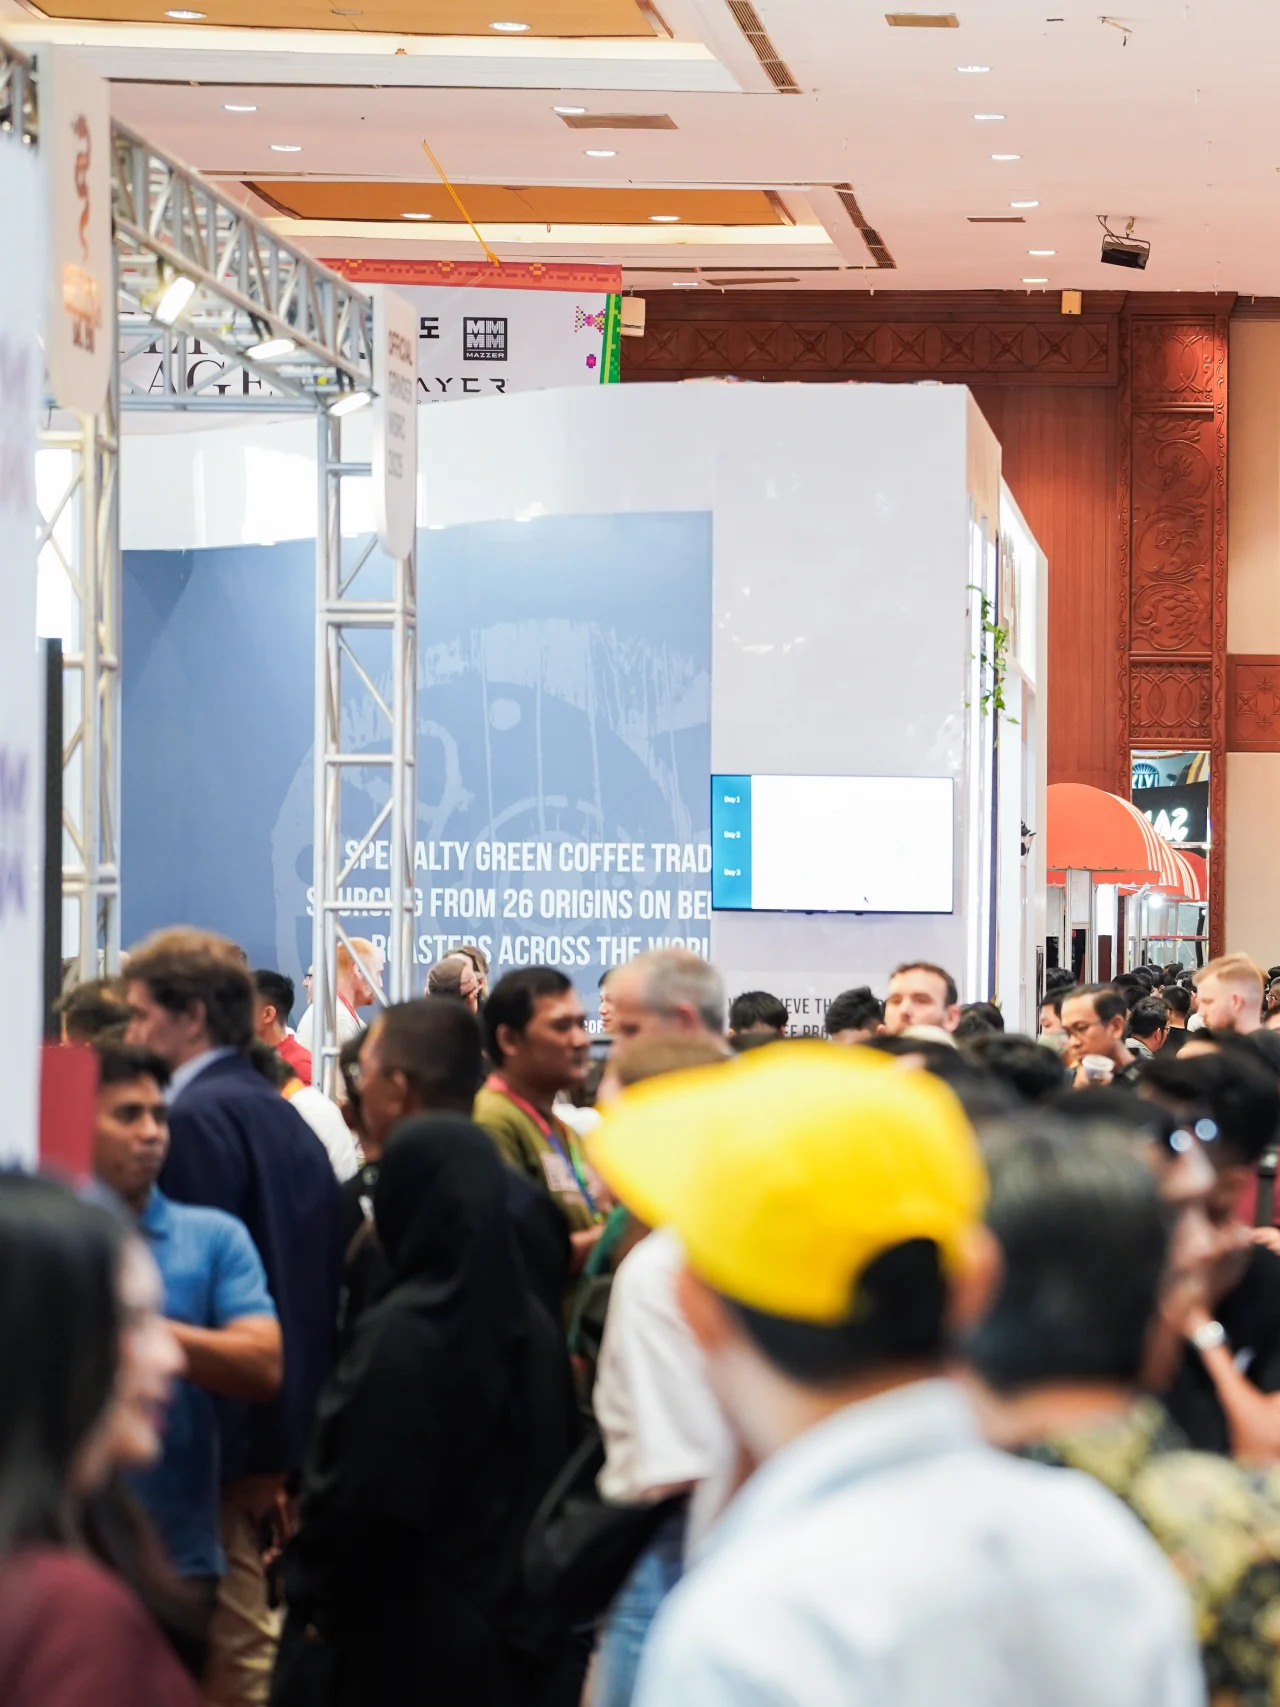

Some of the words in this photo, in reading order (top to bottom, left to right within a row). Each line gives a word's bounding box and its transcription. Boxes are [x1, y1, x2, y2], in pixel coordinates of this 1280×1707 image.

[345, 840, 469, 871] SPEALTY
[476, 841, 552, 872] GREEN
[559, 842, 645, 873] COFFEE
[651, 843, 711, 873] TRAD
[430, 888, 496, 918] FROM
[503, 889, 534, 918] 26
[540, 890, 632, 919] ORIGINS
[639, 890, 671, 919] ON
[499, 935, 590, 965] ACROSS
